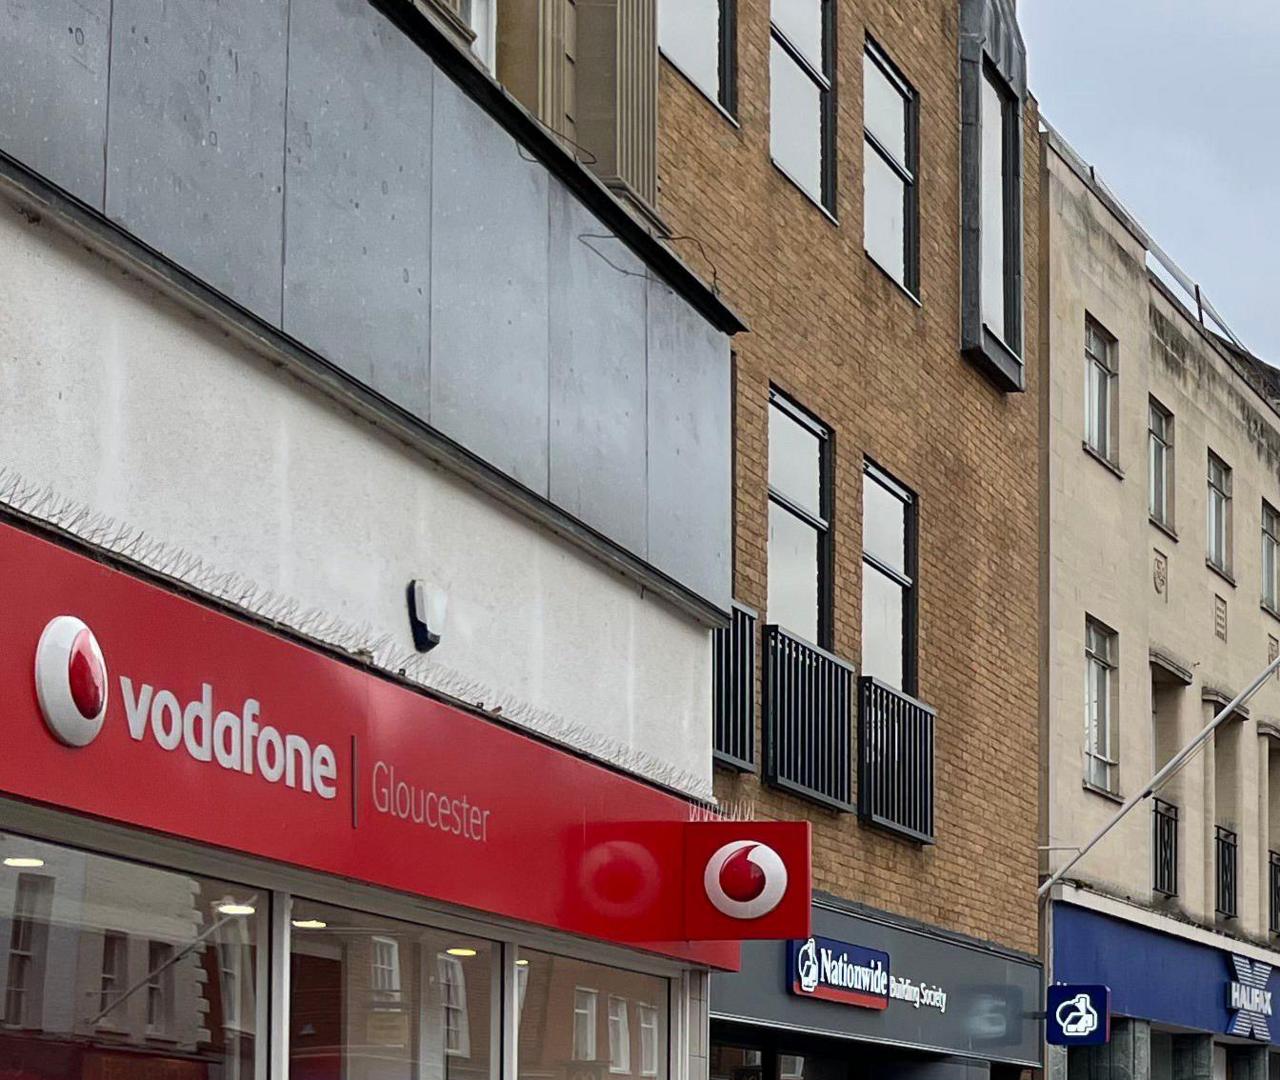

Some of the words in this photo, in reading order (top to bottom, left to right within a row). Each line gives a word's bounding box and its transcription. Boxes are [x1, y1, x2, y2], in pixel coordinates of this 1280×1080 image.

[119, 675, 337, 799] vodafone
[372, 761, 490, 842] Gloucester
[820, 948, 888, 995] Nationwide
[889, 975, 920, 1009] Building
[920, 982, 947, 1013] Society
[1231, 981, 1272, 1017] HALIFAX
